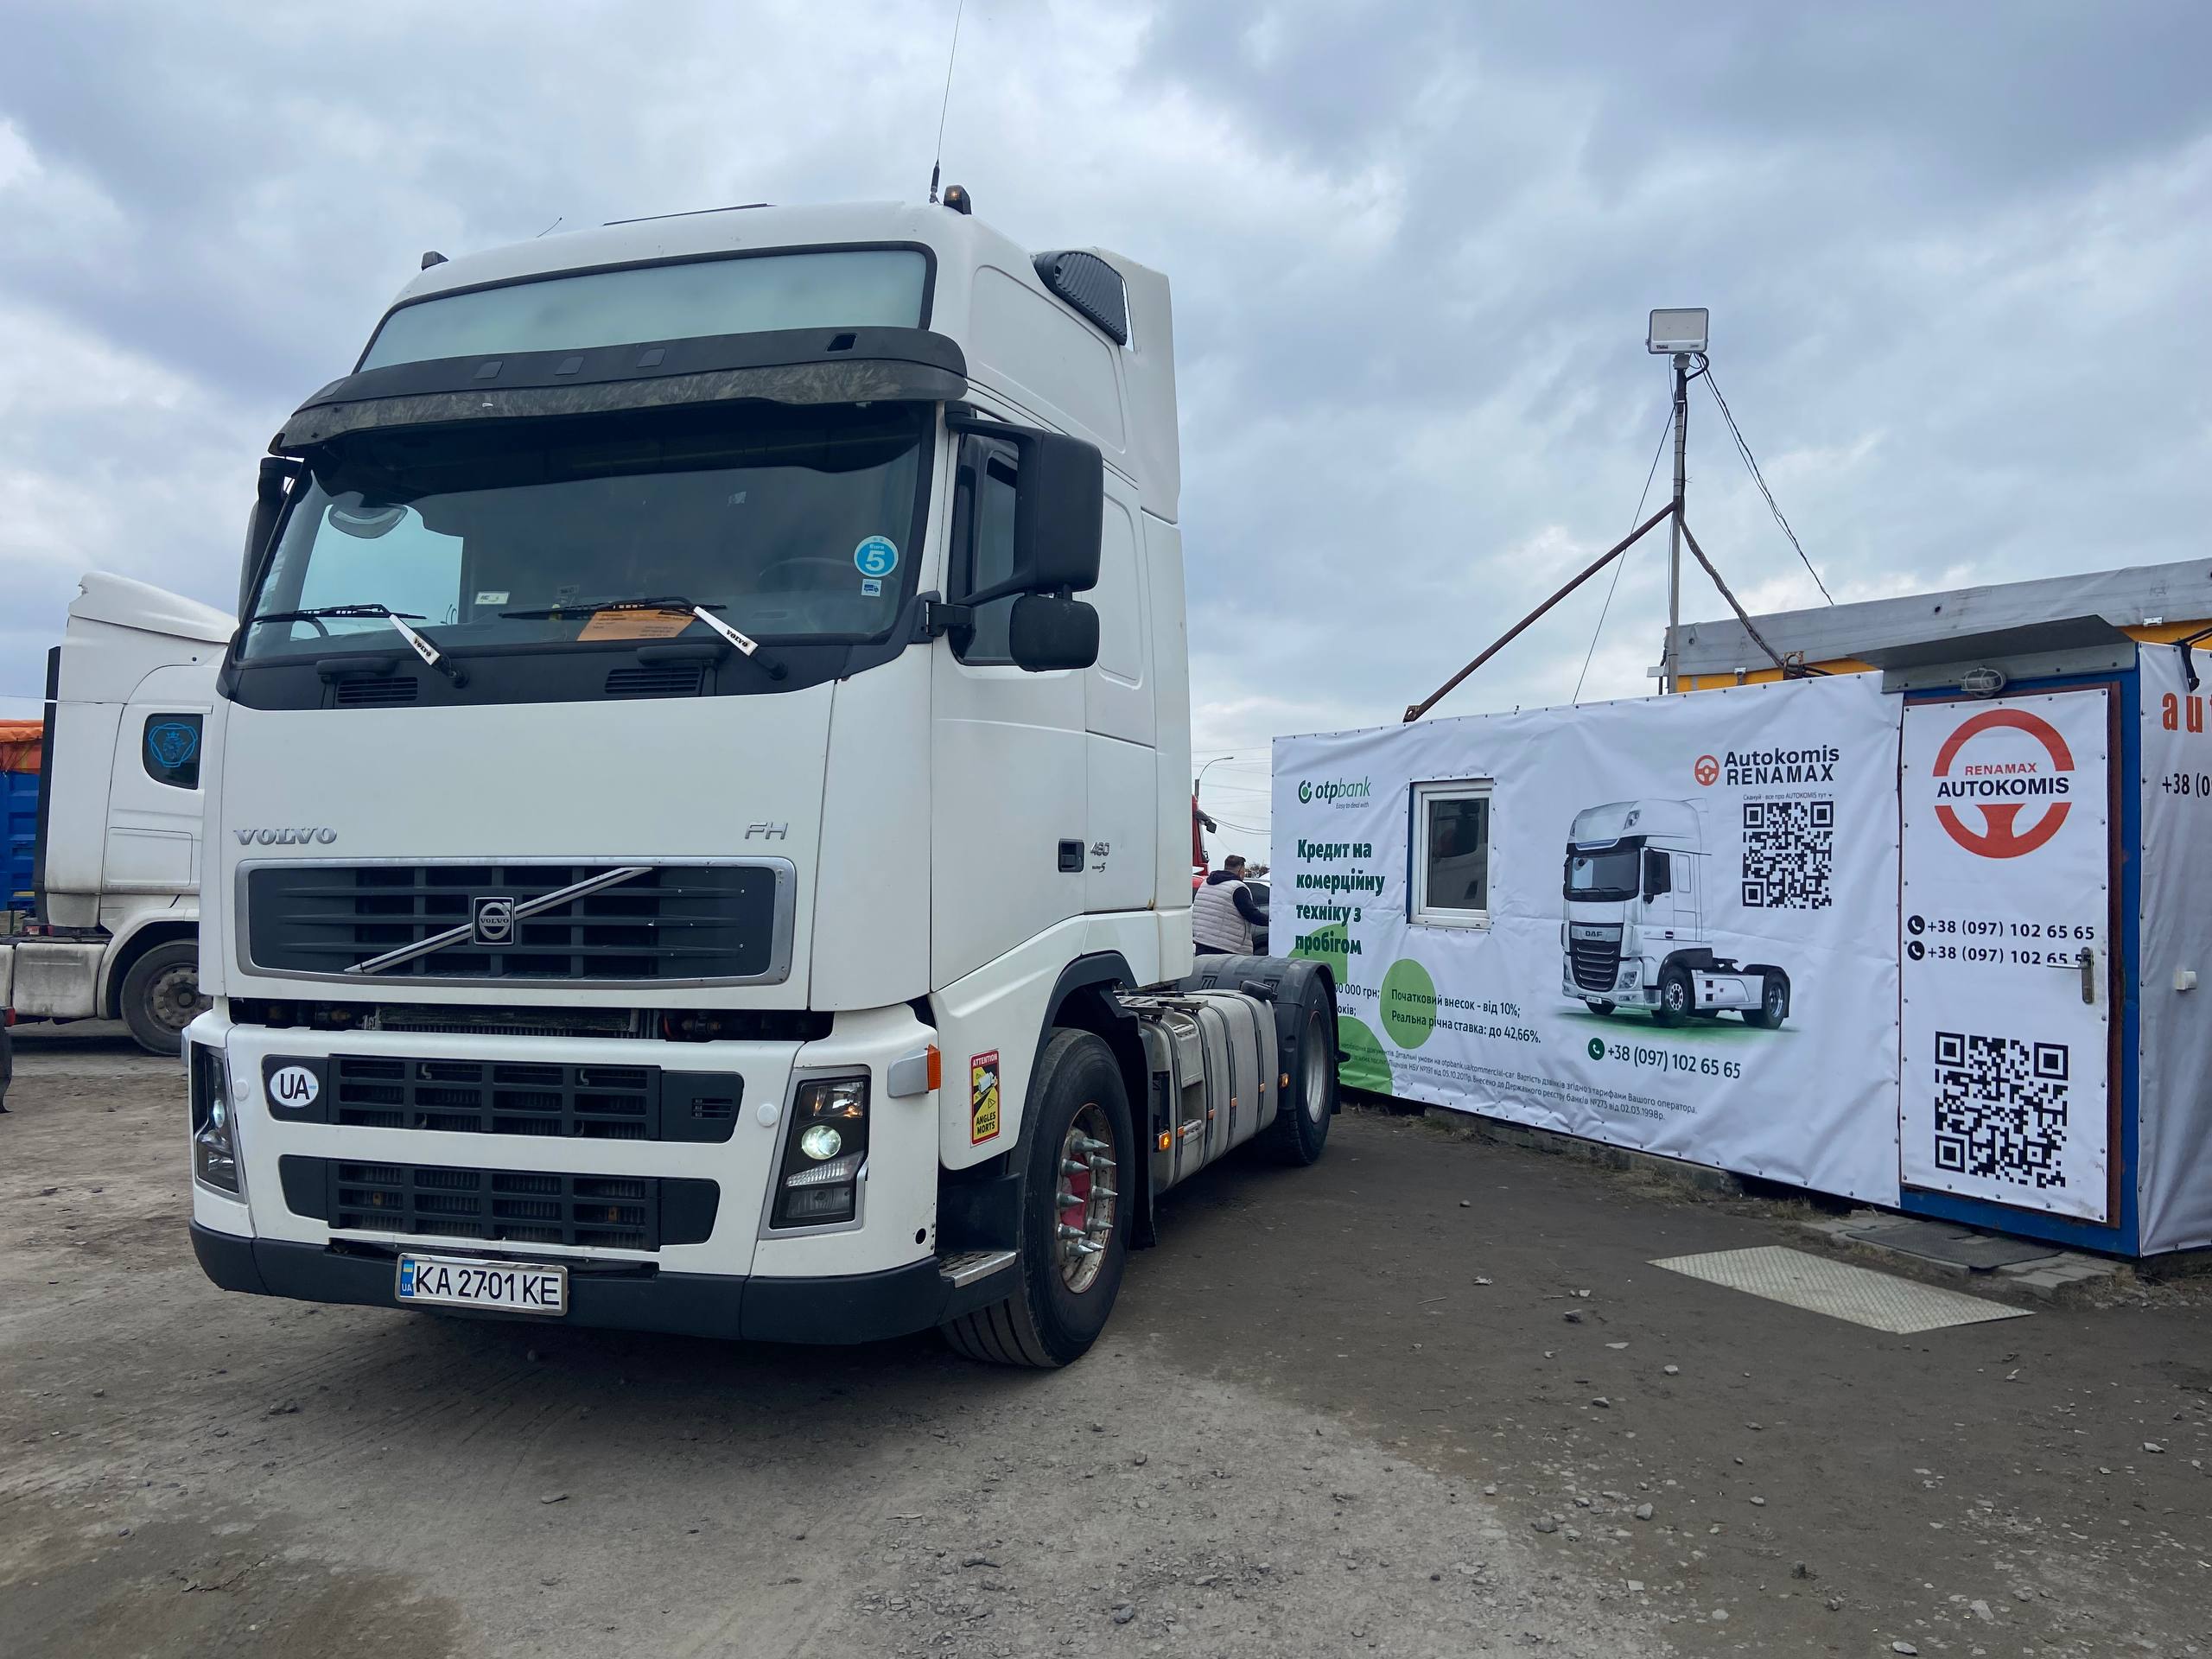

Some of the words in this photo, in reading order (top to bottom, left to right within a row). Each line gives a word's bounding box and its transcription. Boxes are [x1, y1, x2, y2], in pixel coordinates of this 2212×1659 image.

[865, 550, 886, 571] 5
[414, 638, 432, 657] VOLVO
[727, 629, 748, 647] VOLVO
[2162, 692, 2212, 734] au
[1724, 745, 1840, 768] Autokomis
[1726, 764, 1834, 785] RENAMAX
[1965, 762, 2037, 776] RENAMAX
[1315, 775, 1371, 804] otpbank
[1936, 777, 2070, 798] AUTOKOMIS
[2162, 772, 2190, 795] +38
[2196, 772, 2212, 797] (0
[233, 828, 337, 846] VOLVO
[745, 822, 788, 840] FH
[1297, 839, 1350, 862] Кредит
[1353, 842, 1372, 858] на
[1296, 868, 1385, 896] комерційну
[1296, 899, 1351, 927] техніку
[1353, 906, 1362, 922] з
[1928, 920, 1956, 933] +38
[1962, 919, 2004, 937] (097)
[2010, 923, 2041, 938] 102
[2046, 925, 2068, 939] 65
[2074, 926, 2094, 940] 65
[1295, 931, 1363, 956] пробігом
[1928, 946, 1956, 959] +38
[1962, 946, 2004, 963] (097)
[2010, 950, 2041, 964] 102
[2046, 953, 2068, 964] 65
[2075, 954, 2094, 967] 5
[1344, 983, 1361, 995] 000
[1363, 988, 1380, 1000] грн;
[1338, 1004, 1357, 1016] оків;
[1391, 989, 1442, 1006] Початковий
[1444, 997, 1475, 1011] внесок
[1483, 1001, 1497, 1015] від
[1500, 1002, 1521, 1018] 10%;
[1392, 1010, 1427, 1026] Реальна
[1428, 1015, 1452, 1030] річна
[1454, 1021, 1487, 1035] ставка:
[1489, 1027, 1502, 1038] до
[1504, 1026, 1541, 1044] 42,66%.
[972, 1053, 998, 1067] ATTENTION
[1608, 1044, 1630, 1062] +38
[1634, 1046, 1669, 1071] (097)
[1672, 1053, 1696, 1072] 102
[1700, 1058, 1719, 1077] 65
[1723, 1062, 1741, 1079] 65
[280, 1073, 310, 1100] UA
[1628, 1093, 1656, 1106] Вашого
[976, 1111, 996, 1126] ANGLES
[976, 1121, 995, 1135] MORTS
[402, 1284, 413, 1293] UA
[416, 1265, 452, 1296] KA
[458, 1269, 515, 1302] 2701
[523, 1274, 560, 1306] KE
